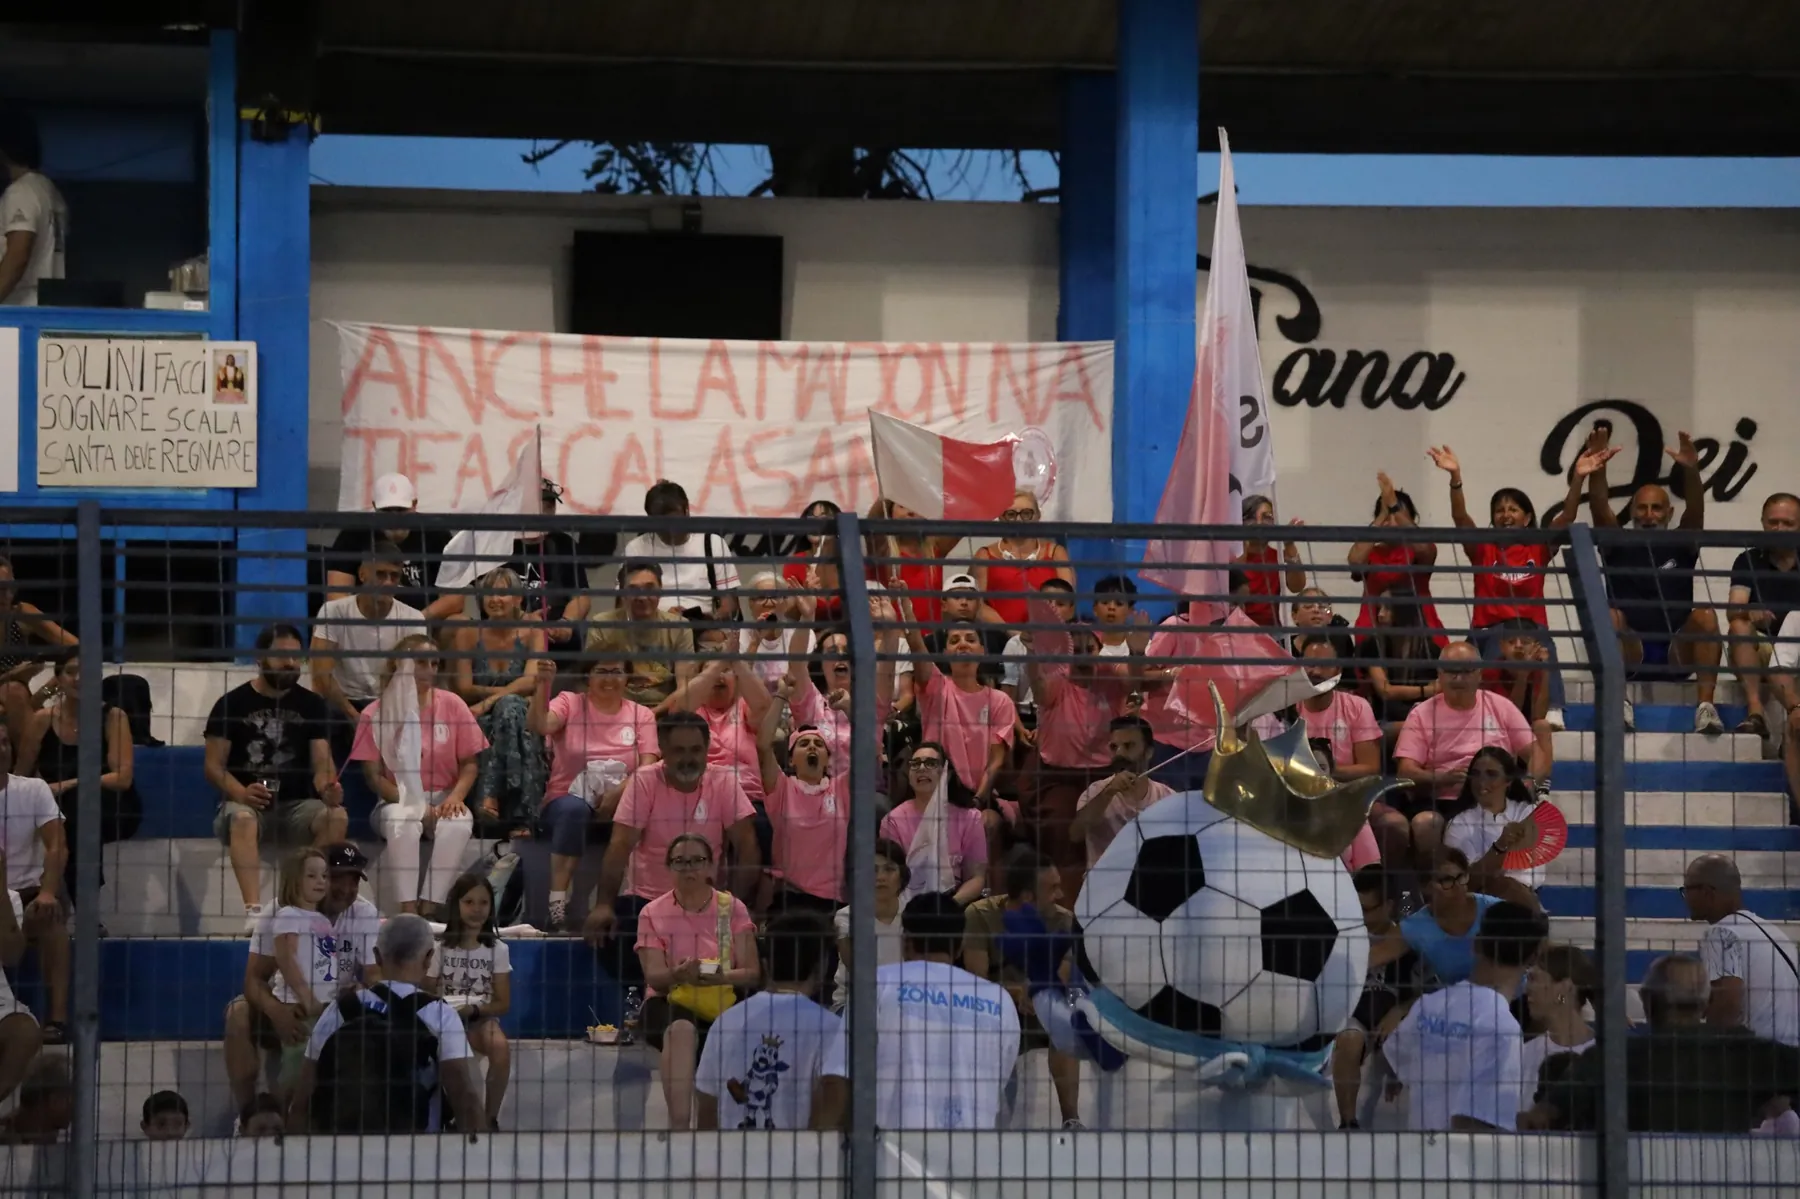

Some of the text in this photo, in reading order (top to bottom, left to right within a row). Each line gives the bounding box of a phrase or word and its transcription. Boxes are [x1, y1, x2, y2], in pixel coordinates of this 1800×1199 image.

[341, 326, 1104, 432] ANCHE LA MADONNA
[40, 393, 242, 434] SOGNARE SCALA
[39, 435, 255, 475] SANTA DEVE REGNARE
[897, 984, 949, 1007] ZONA
